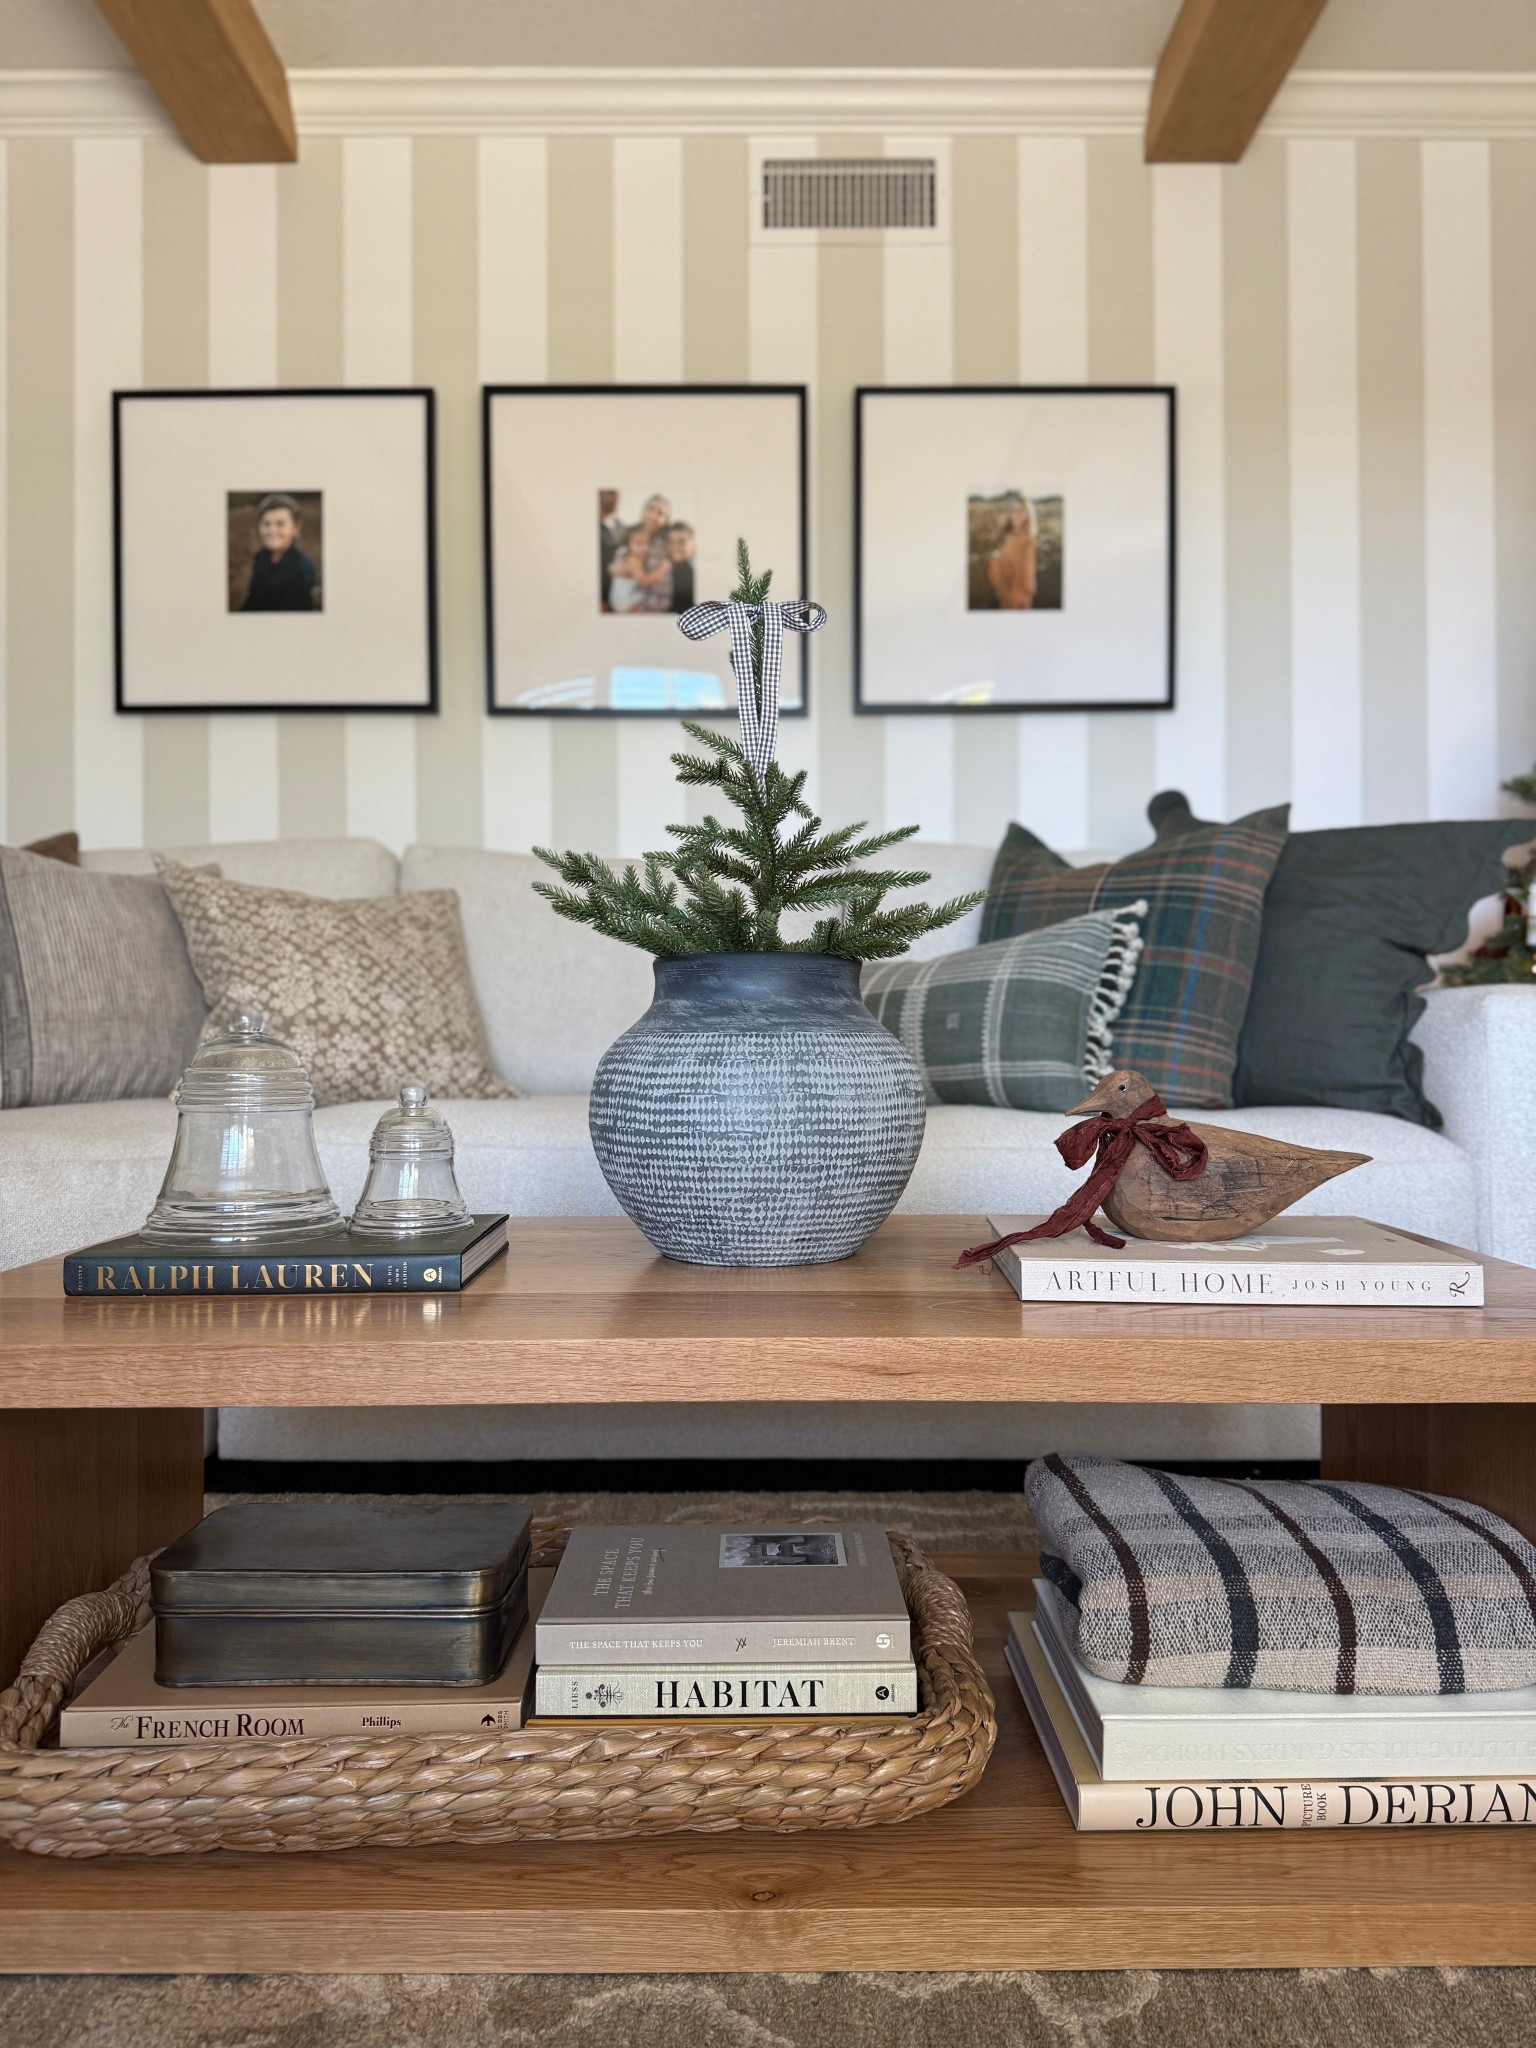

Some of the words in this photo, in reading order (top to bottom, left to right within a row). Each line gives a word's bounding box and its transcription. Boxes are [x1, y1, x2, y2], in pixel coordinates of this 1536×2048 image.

[96, 1265, 216, 1290] RALPH
[230, 1263, 374, 1289] LAUREN
[1046, 1270, 1166, 1292] ARTFUL
[1180, 1272, 1273, 1294] HOME
[1292, 1279, 1345, 1291] JOSH
[1359, 1280, 1431, 1292] YOUNG
[628, 1537, 645, 1555] YOU
[600, 1548, 619, 1575] SPACE
[621, 1556, 641, 1582] KEEPS
[594, 1578, 612, 1596] THE
[614, 1584, 634, 1609] THAT
[569, 1640, 590, 1649] THE
[592, 1640, 621, 1649] SPACE
[623, 1640, 650, 1648] THAT
[652, 1639, 681, 1648] KEEPS
[683, 1639, 703, 1648] YOU
[772, 1637, 821, 1648] JEREMIAH
[823, 1636, 855, 1646] BRENT
[571, 1681, 579, 1709] LIESS
[655, 1679, 824, 1708] HABITAT
[110, 1715, 133, 1731] The
[135, 1715, 230, 1740] FRENCH
[235, 1713, 306, 1738] ROOM
[361, 1716, 402, 1730] Phillips
[1136, 1786, 1288, 1828] JOHN
[1300, 1783, 1313, 1827] PICTURE
[1316, 1793, 1328, 1821] BOOK
